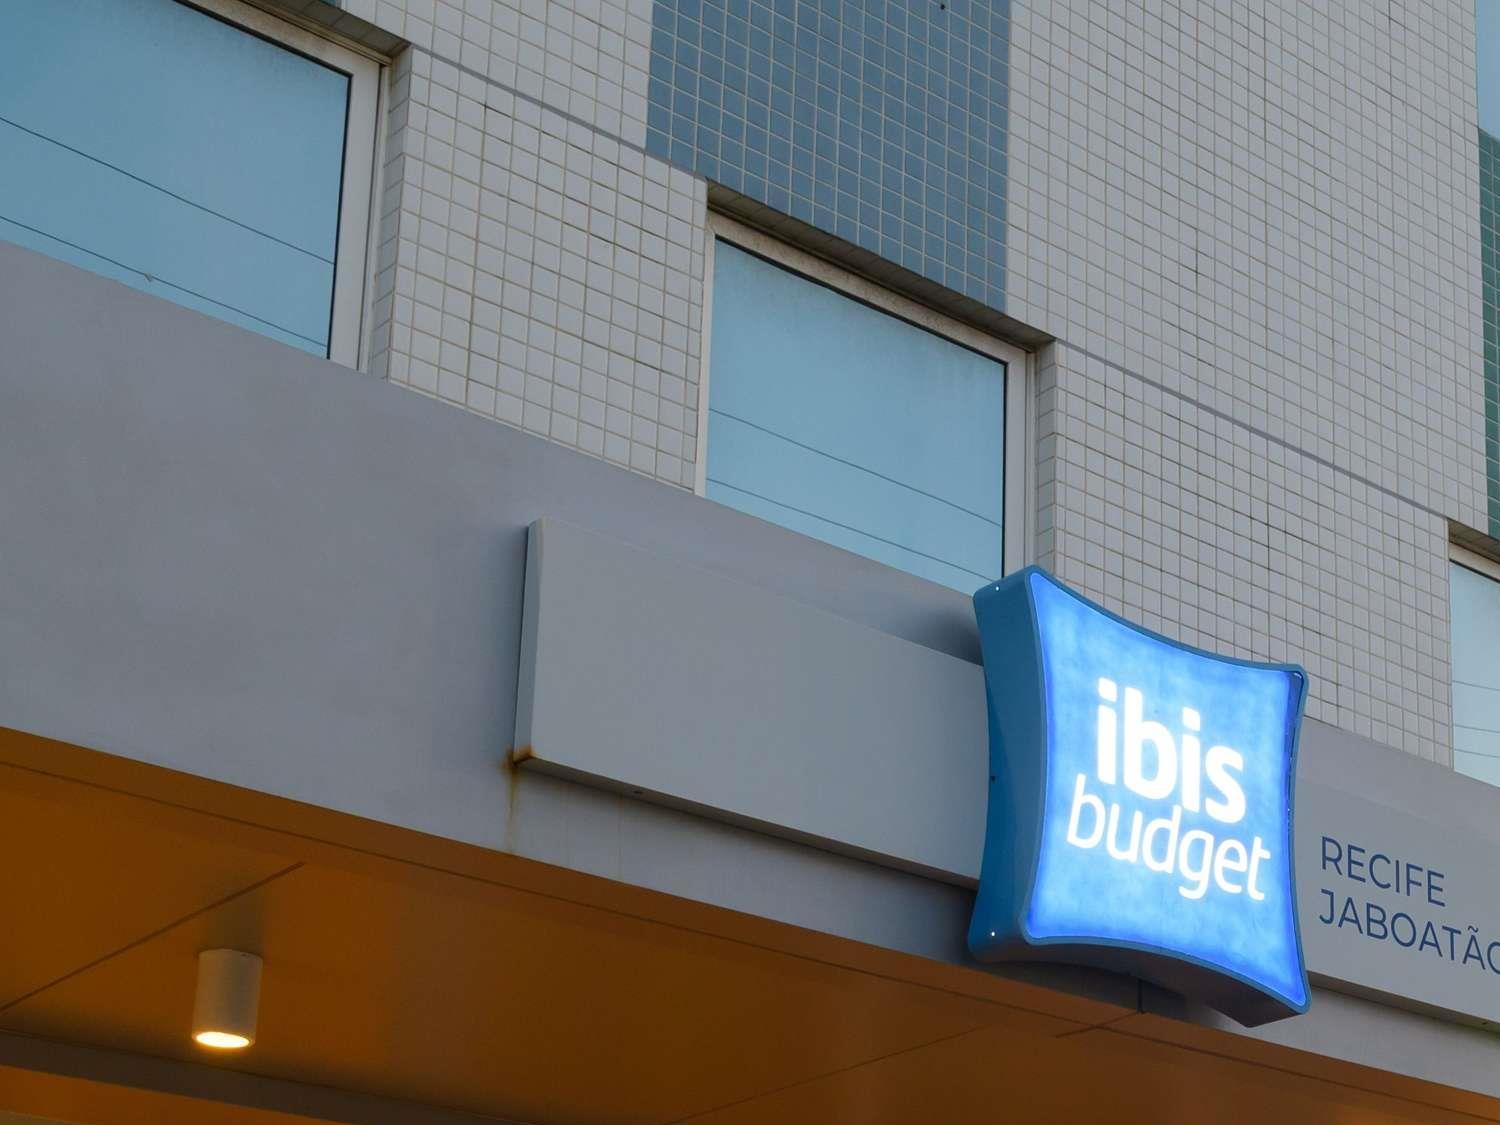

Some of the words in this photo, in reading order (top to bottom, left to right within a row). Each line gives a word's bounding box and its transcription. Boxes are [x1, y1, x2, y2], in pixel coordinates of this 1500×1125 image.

[1097, 676, 1247, 824] ibis
[1066, 772, 1271, 901] budget
[1321, 835, 1446, 908] RECIFE
